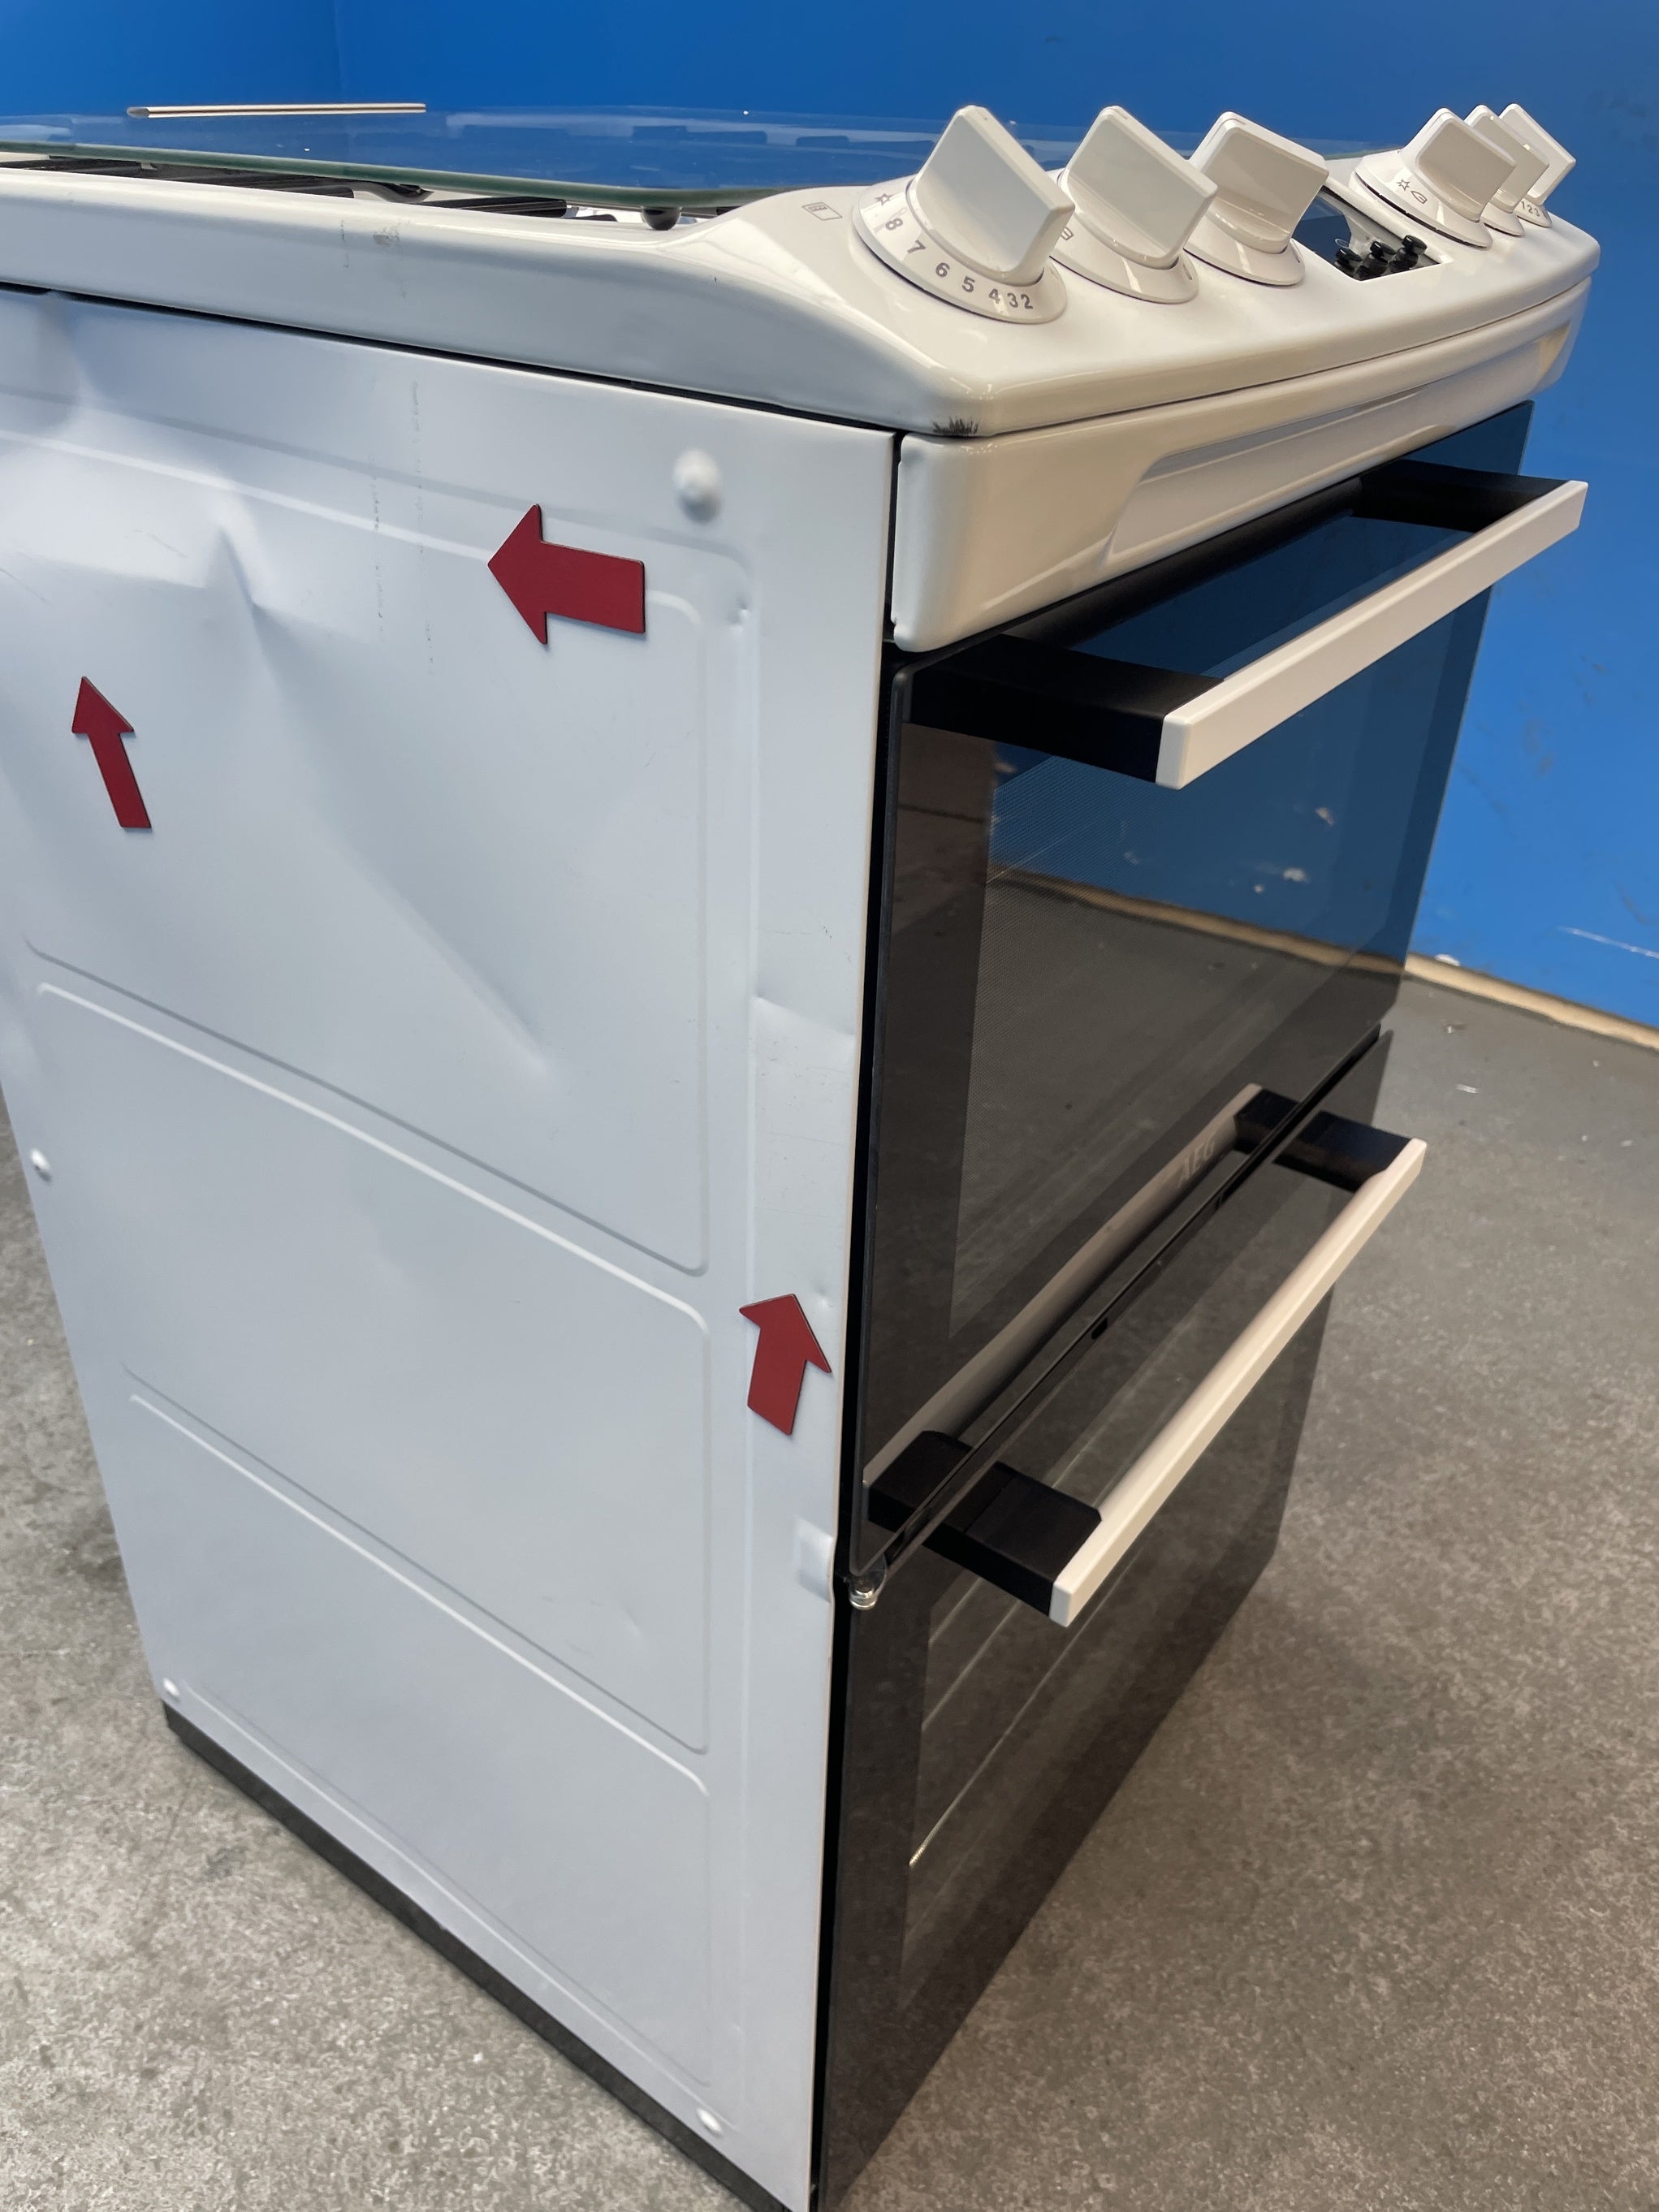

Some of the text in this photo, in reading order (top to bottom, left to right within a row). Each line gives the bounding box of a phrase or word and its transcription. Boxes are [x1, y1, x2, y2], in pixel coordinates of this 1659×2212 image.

[885, 218, 903, 231] 8
[907, 240, 926, 253] 7
[935, 262, 950, 278] 6
[962, 276, 975, 292] 5
[1177, 1130, 1217, 1190] AEG
